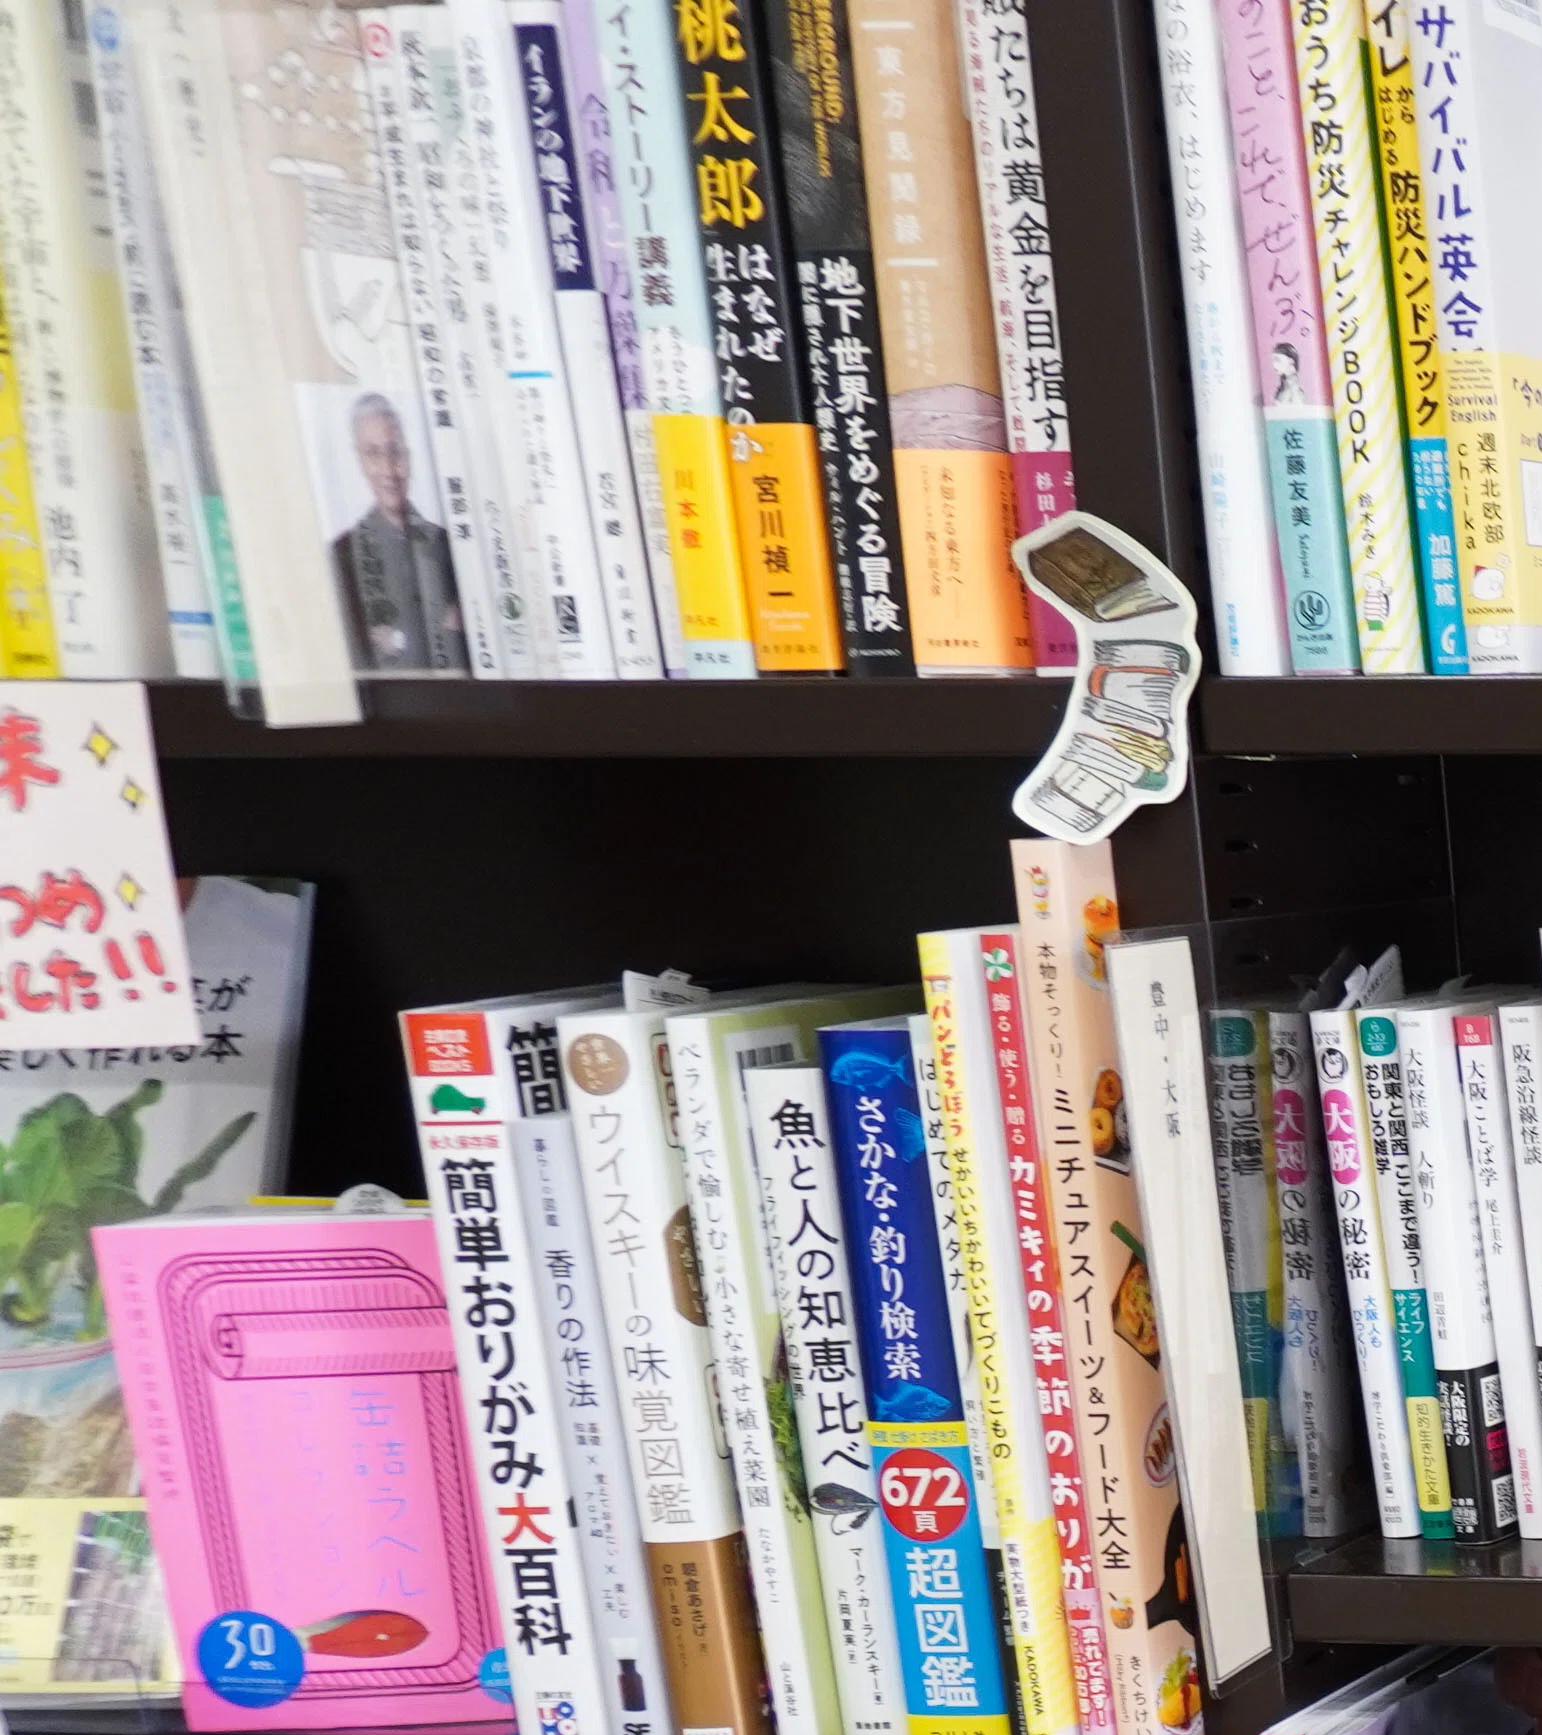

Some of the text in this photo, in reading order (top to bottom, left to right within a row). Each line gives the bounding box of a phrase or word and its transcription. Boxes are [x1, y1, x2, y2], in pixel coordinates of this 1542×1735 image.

[820, 257, 903, 631] 地下世界をめぐる冒険
[1456, 444, 1476, 551] chika
[1476, 432, 1505, 545] 週末北欧部
[1324, 1095, 1372, 1280] 大阪の秘密
[1468, 1059, 1497, 1187] 大阪ことば学
[1512, 1042, 1542, 1166] 阪急沿線怪談
[585, 1105, 694, 1525] ウイスキーの味覚図鑑
[771, 1098, 874, 1472] 魚と人の知恵比べ
[853, 1093, 921, 1381] さかな・釣り検索
[439, 1158, 571, 1658] 簡単おりがみ大百科
[544, 1248, 600, 1408] 香りの作法
[1050, 1086, 1133, 1570] ミニチュアスイーツ&フード大全
[880, 1468, 966, 1511] 672
[905, 1547, 983, 1709] 超図鑑
